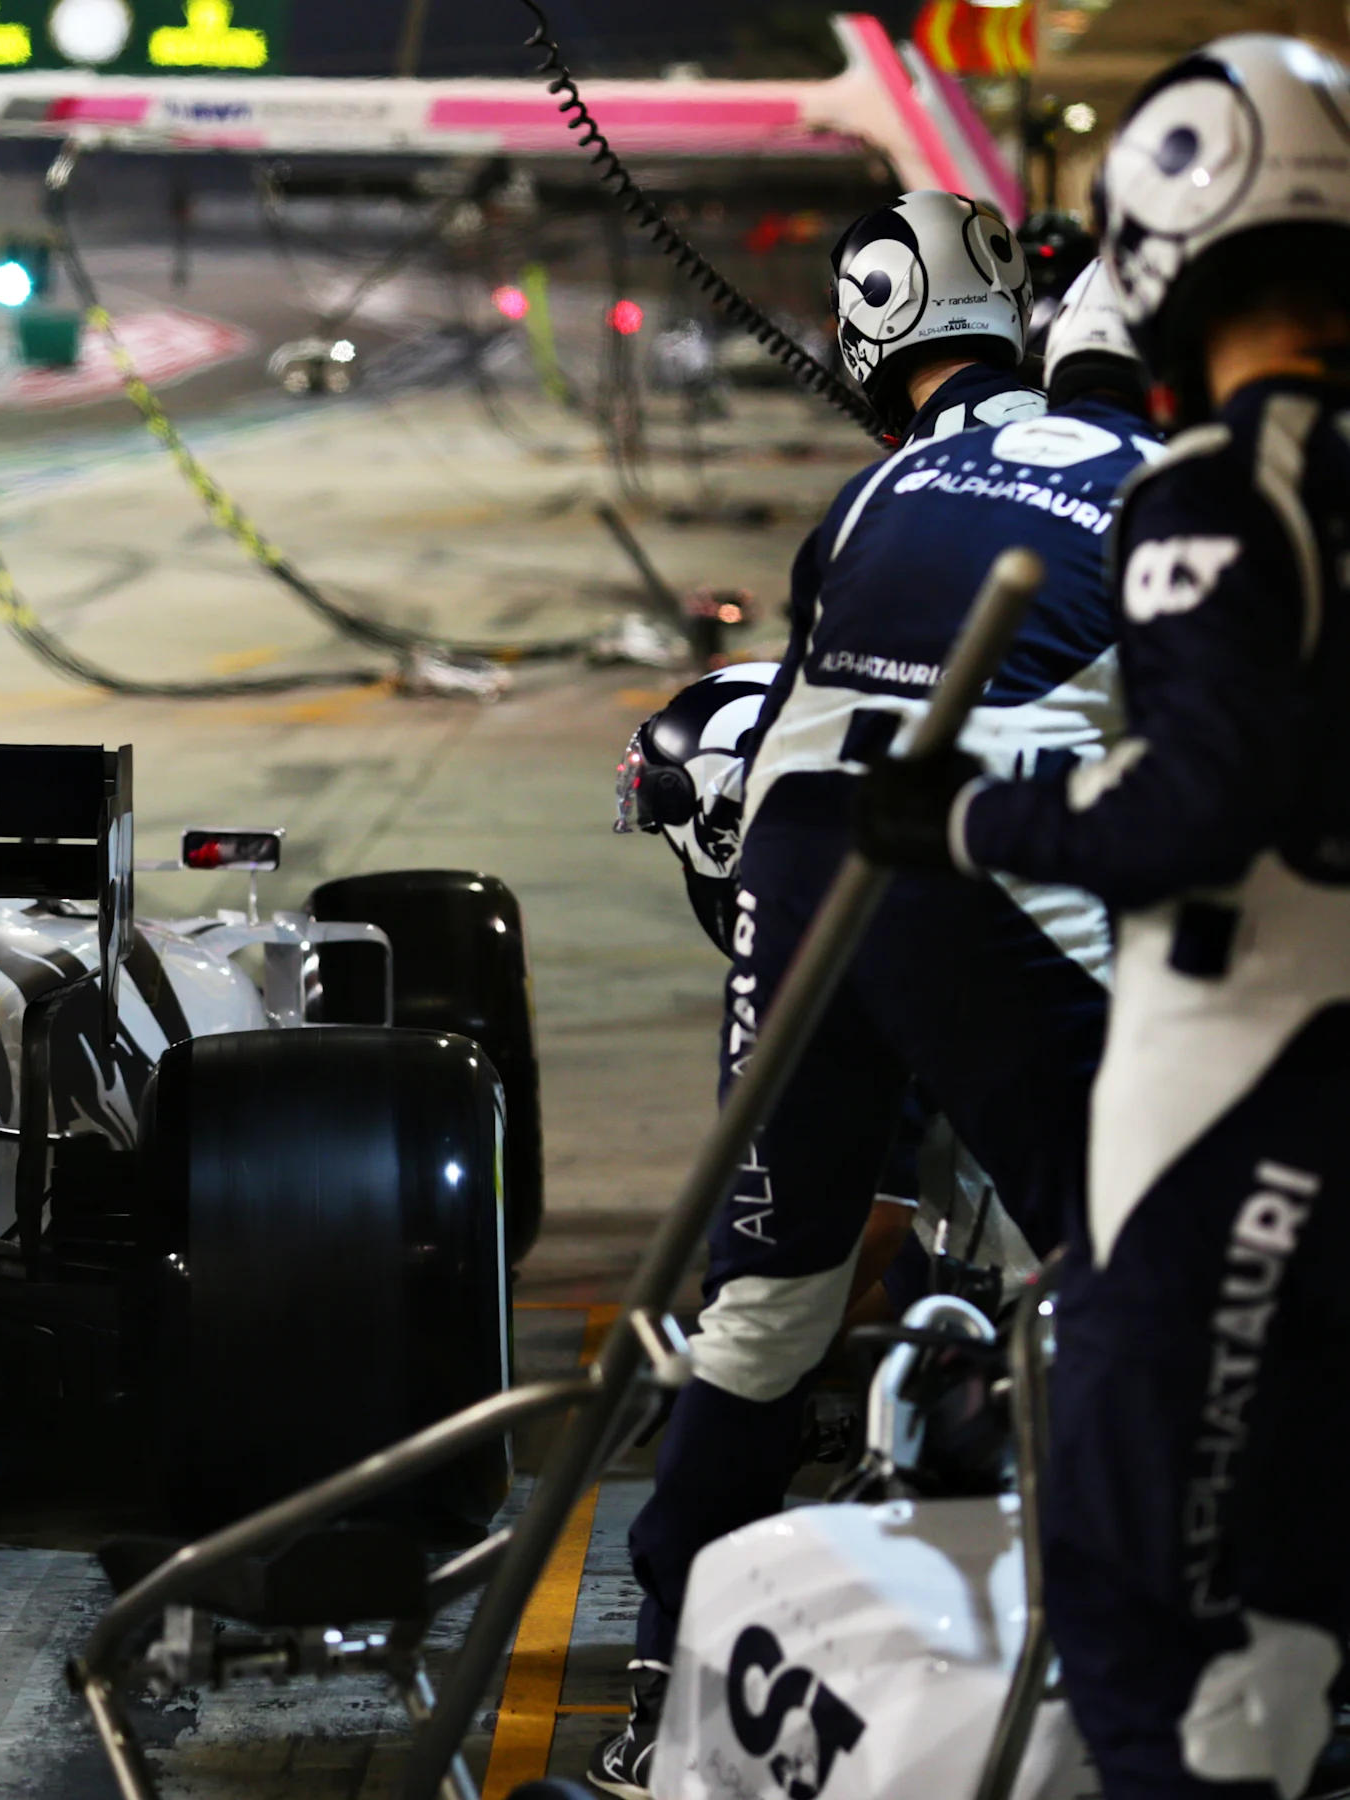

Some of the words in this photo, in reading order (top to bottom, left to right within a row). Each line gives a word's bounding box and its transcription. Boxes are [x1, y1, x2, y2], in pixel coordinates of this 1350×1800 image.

[948, 293, 988, 306] randstad
[918, 321, 990, 338] ALPHATAURI.COM
[928, 471, 1113, 536] ALPHATAURI
